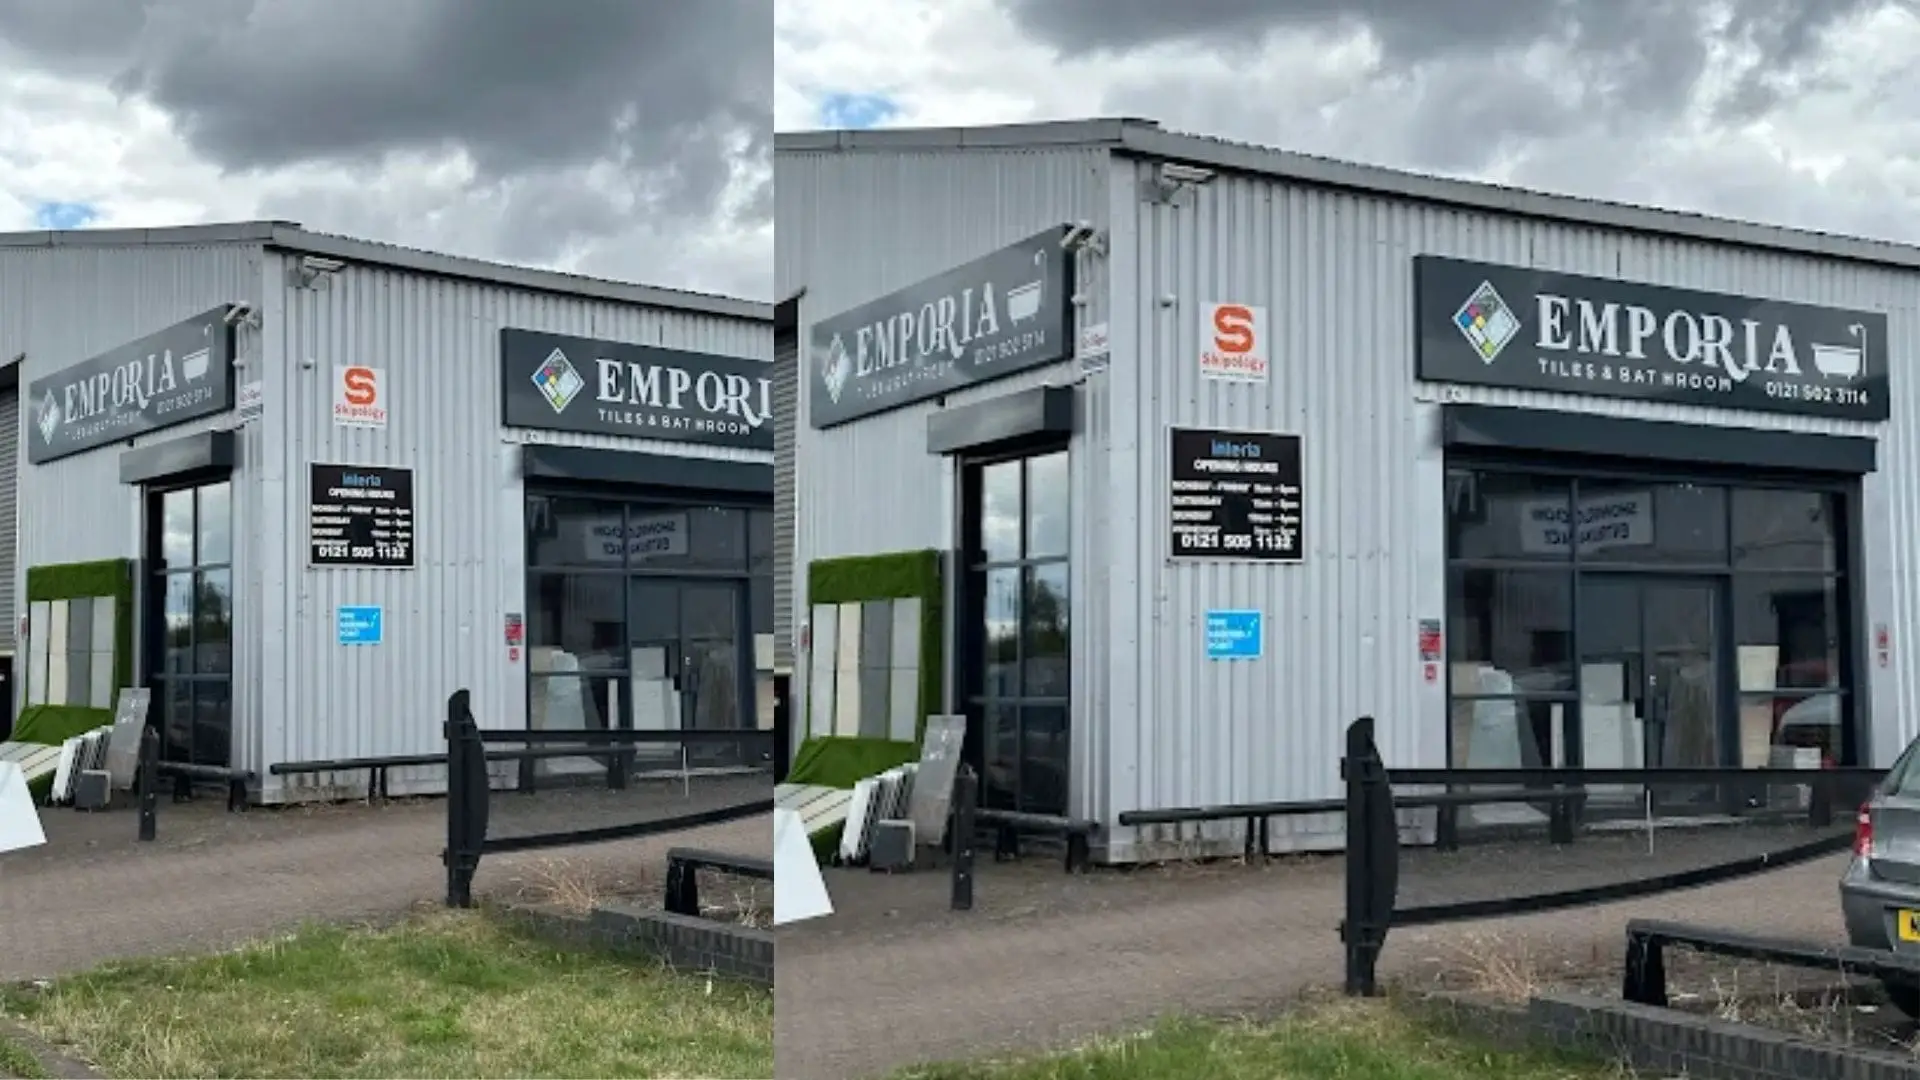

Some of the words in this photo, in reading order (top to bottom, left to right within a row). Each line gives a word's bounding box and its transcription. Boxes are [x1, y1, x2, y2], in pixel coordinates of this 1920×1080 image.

[855, 281, 1000, 378] EMPORIA
[1214, 306, 1254, 352] S
[1534, 294, 1803, 382] EMPORIA
[1538, 357, 1596, 380] TILES
[1601, 364, 1613, 381] &
[64, 348, 177, 424] EMPORIA
[344, 367, 377, 404] S
[1765, 381, 1798, 399] 0121
[1835, 387, 1869, 405] 3114
[598, 408, 644, 426] TILES
[318, 545, 349, 558] 0121
[1181, 533, 1219, 548] 0121
